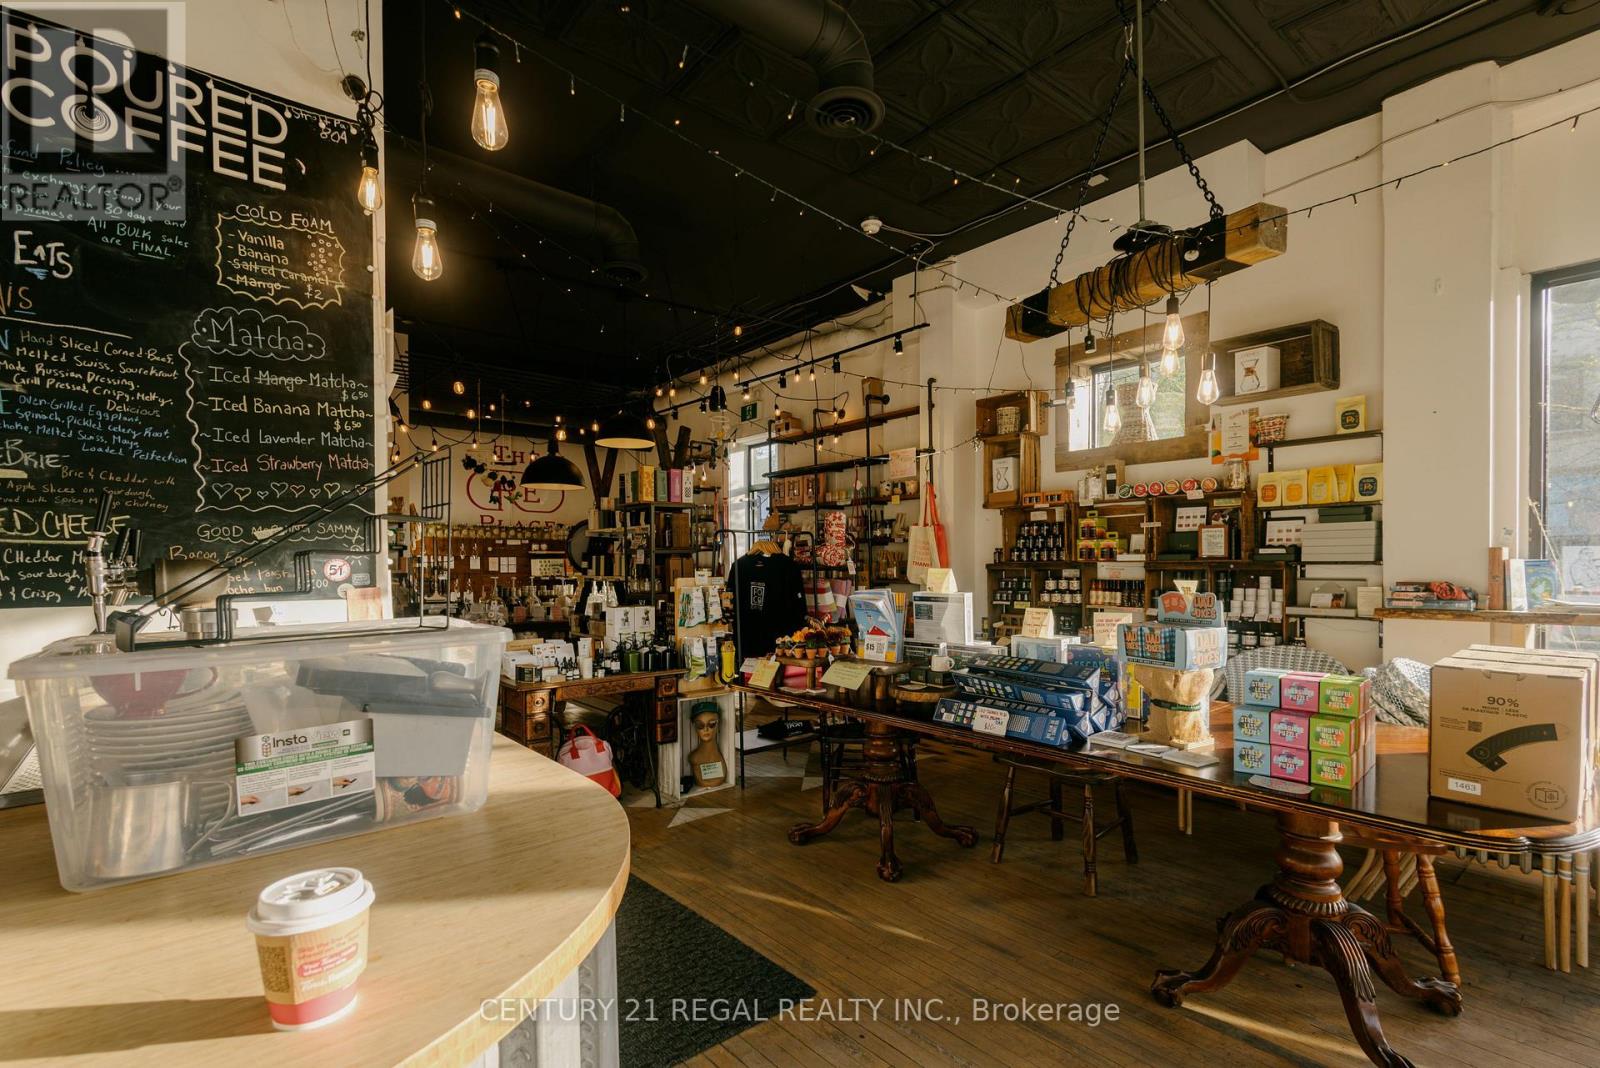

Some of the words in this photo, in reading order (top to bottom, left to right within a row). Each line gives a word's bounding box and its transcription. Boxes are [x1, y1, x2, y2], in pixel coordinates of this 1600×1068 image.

[6, 23, 288, 145] POURED
[1, 77, 287, 190] COFFEE
[236, 204, 282, 222] COLD
[290, 213, 334, 234] FOAM
[117, 222, 152, 240] BULK
[20, 330, 53, 346] Hand
[60, 335, 99, 352] Sliced
[207, 316, 304, 351] Matcha
[16, 347, 67, 362] Melted
[13, 373, 40, 385] Grill
[35, 362, 83, 379] Russian
[107, 399, 161, 418] Delicious
[253, 398, 310, 416] Banana
[259, 428, 316, 445] Lavender
[256, 454, 323, 481] Strawberry
[197, 523, 244, 539] GOOD
[1487, 696, 1519, 708] 90%
[273, 734, 308, 748] Insta
